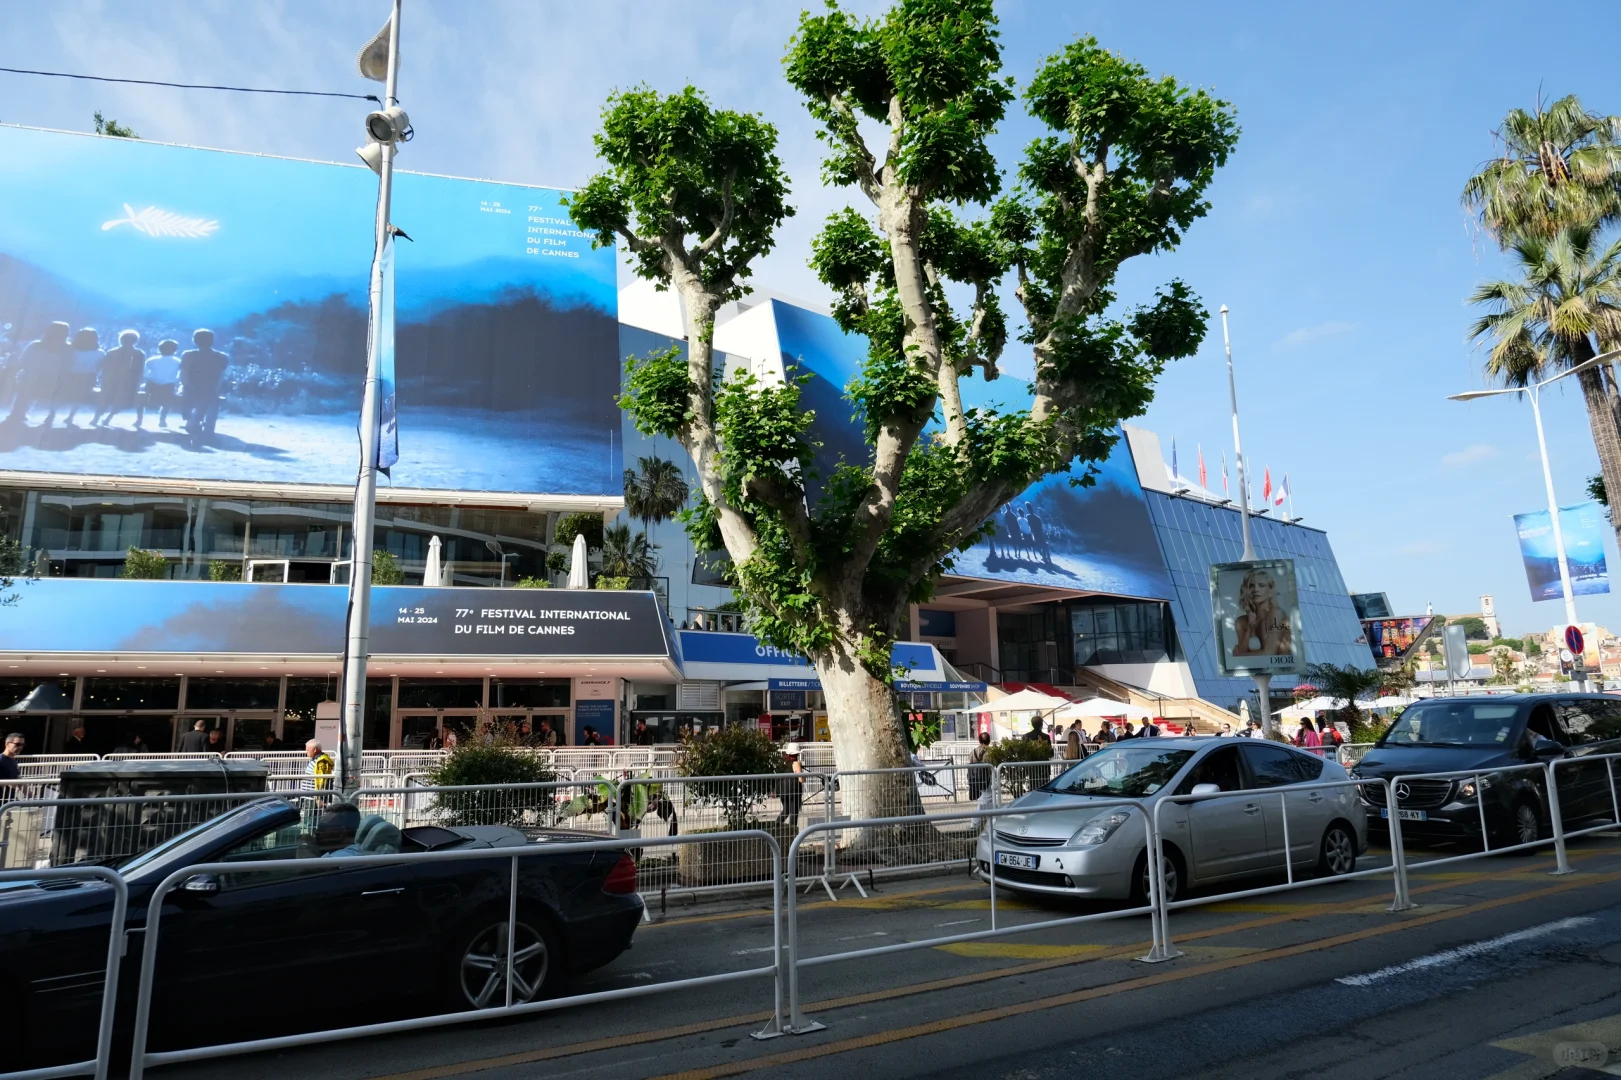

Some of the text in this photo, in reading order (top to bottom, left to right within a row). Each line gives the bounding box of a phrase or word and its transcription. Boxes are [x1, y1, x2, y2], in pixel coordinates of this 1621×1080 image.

[528, 216, 571, 226] FESTIVAL
[528, 227, 596, 239] INTERNATIONA
[543, 238, 566, 246] FILM
[542, 249, 580, 258] CANNES
[481, 609, 536, 618] FESTIVAL
[540, 610, 631, 620] INTERNATIONAL
[455, 624, 575, 635] DU FILM DE CANNES
[1270, 656, 1294, 664] DIOR
